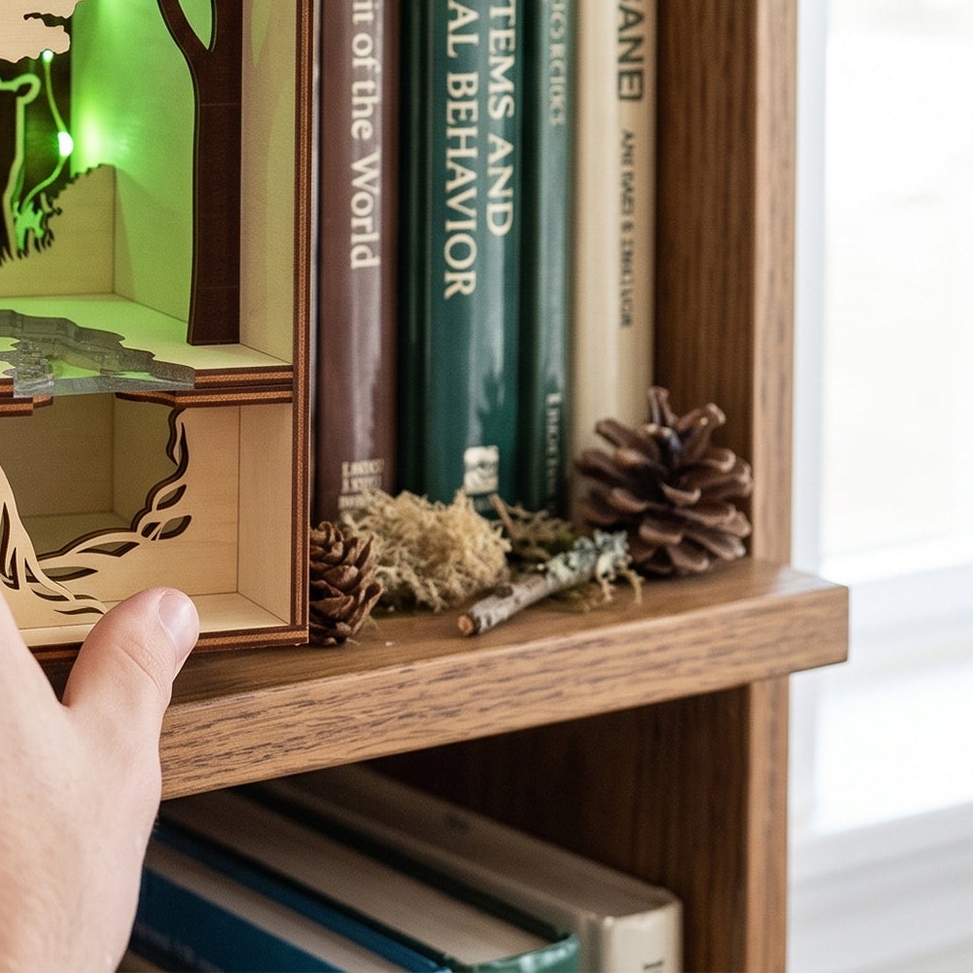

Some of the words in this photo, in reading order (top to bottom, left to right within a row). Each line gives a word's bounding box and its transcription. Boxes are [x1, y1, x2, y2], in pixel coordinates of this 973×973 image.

[352, 32, 382, 73] of
[352, 81, 380, 141] the
[350, 152, 381, 270] World
[442, 71, 480, 300] BEHAVIOR
[485, 133, 516, 238] AND
